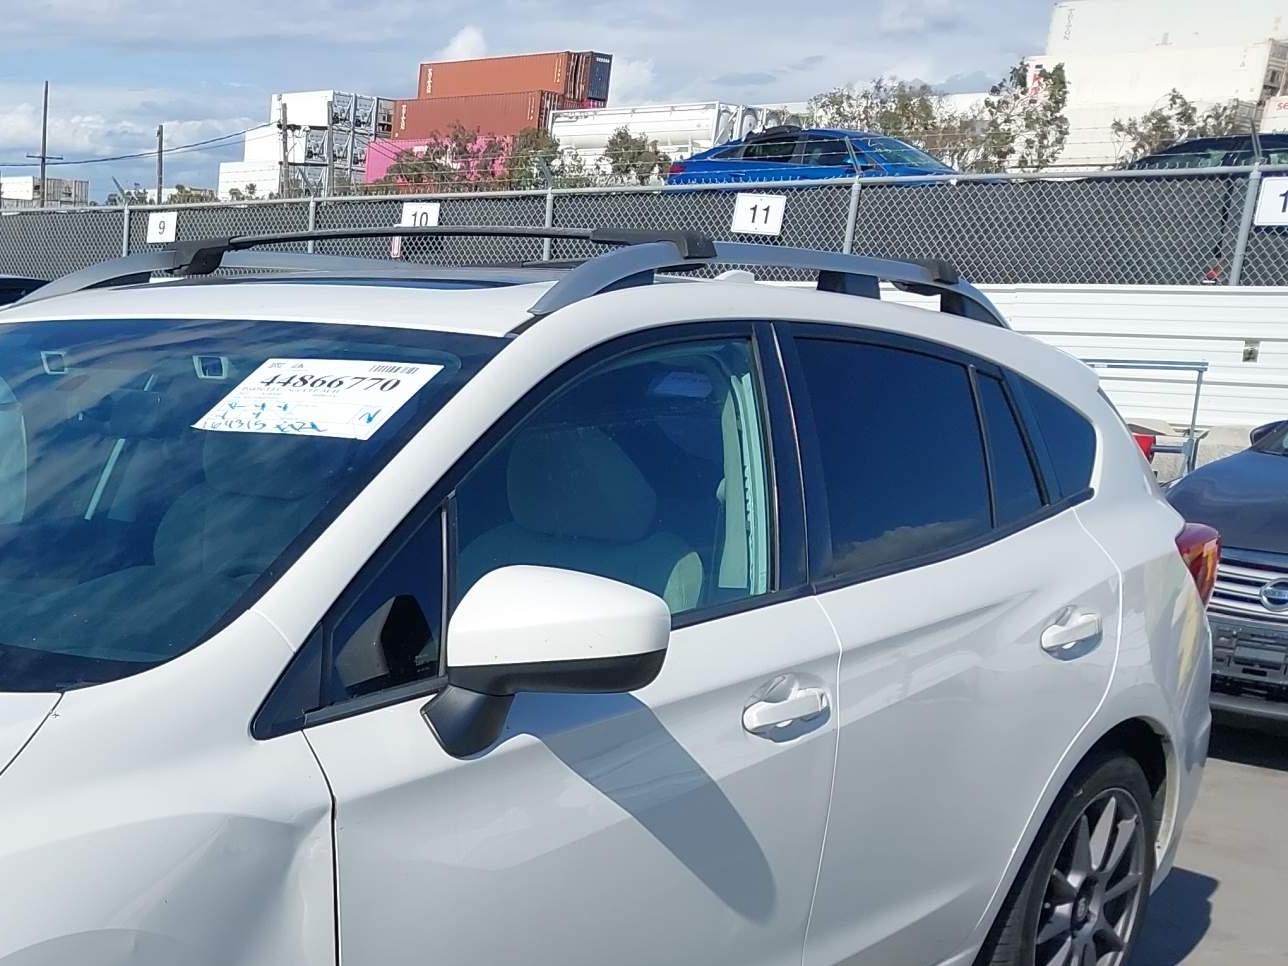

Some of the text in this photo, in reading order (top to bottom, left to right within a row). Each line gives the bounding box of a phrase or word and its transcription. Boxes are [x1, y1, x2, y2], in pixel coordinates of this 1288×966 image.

[412, 211, 430, 226] 10
[749, 204, 770, 225] 11
[158, 220, 166, 235] 9
[260, 374, 401, 392] 44866770
